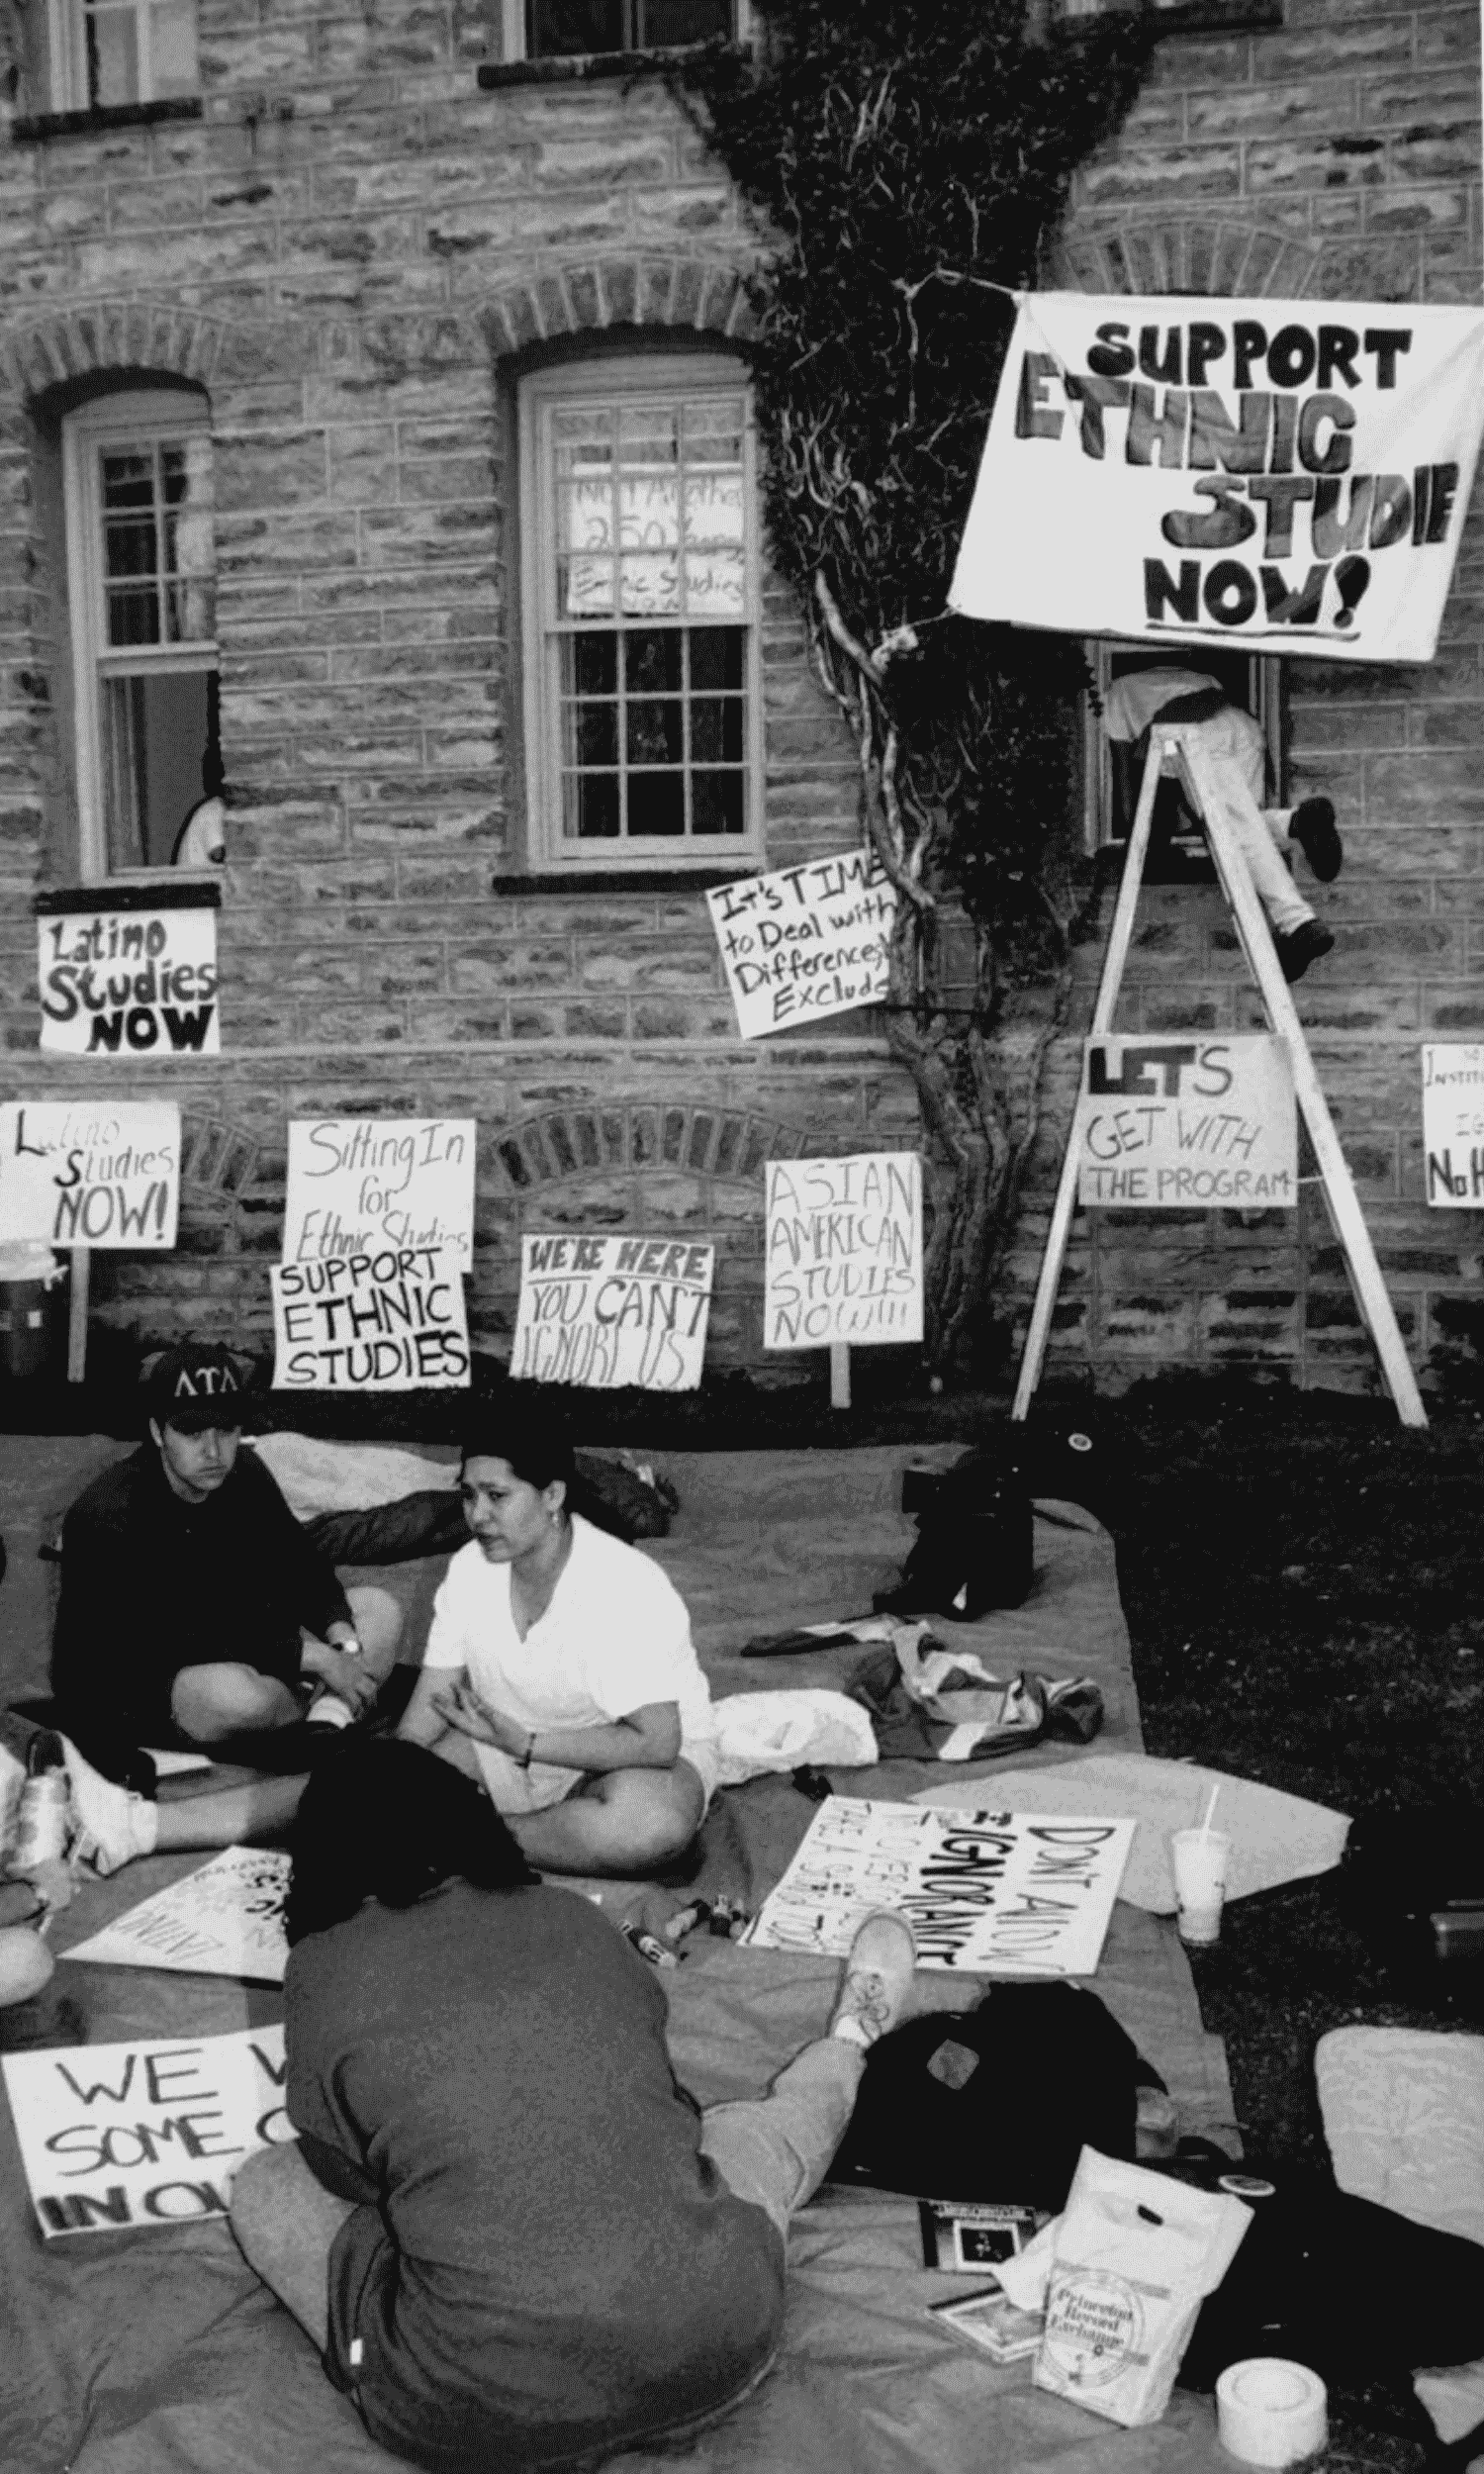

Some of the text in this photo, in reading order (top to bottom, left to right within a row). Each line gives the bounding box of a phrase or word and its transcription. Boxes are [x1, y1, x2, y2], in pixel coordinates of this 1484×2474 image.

[1086, 320, 1414, 391] SUPPORT
[1014, 349, 1357, 475] ETHNIC
[1143, 554, 1372, 627] NOW!
[712, 857, 887, 922] It's TIME
[48, 917, 167, 963] Latino
[724, 893, 897, 960] to Deal with
[42, 958, 219, 1022] Studies
[85, 1003, 216, 1053] NOW
[302, 1121, 465, 1194] Sitting In
[1086, 1106, 1262, 1161] GET WITH
[52, 1145, 175, 1188] Studies
[358, 1175, 394, 1216] for
[769, 1161, 914, 1219] ASIAN
[1087, 1166, 1290, 1200] THE PROGRAM
[54, 1181, 169, 1241] NOW!
[280, 1246, 442, 1296] SUPPORT
[614, 1240, 711, 1281] HERE
[770, 1263, 916, 1310] STUDIES
[284, 1282, 452, 1344] ETHNIC
[531, 1284, 588, 1324] YOU
[284, 1329, 470, 1384] STUDIES
[637, 1326, 686, 1387] US
[54, 2046, 220, 2105] WE
[44, 2110, 246, 2177] SOME
